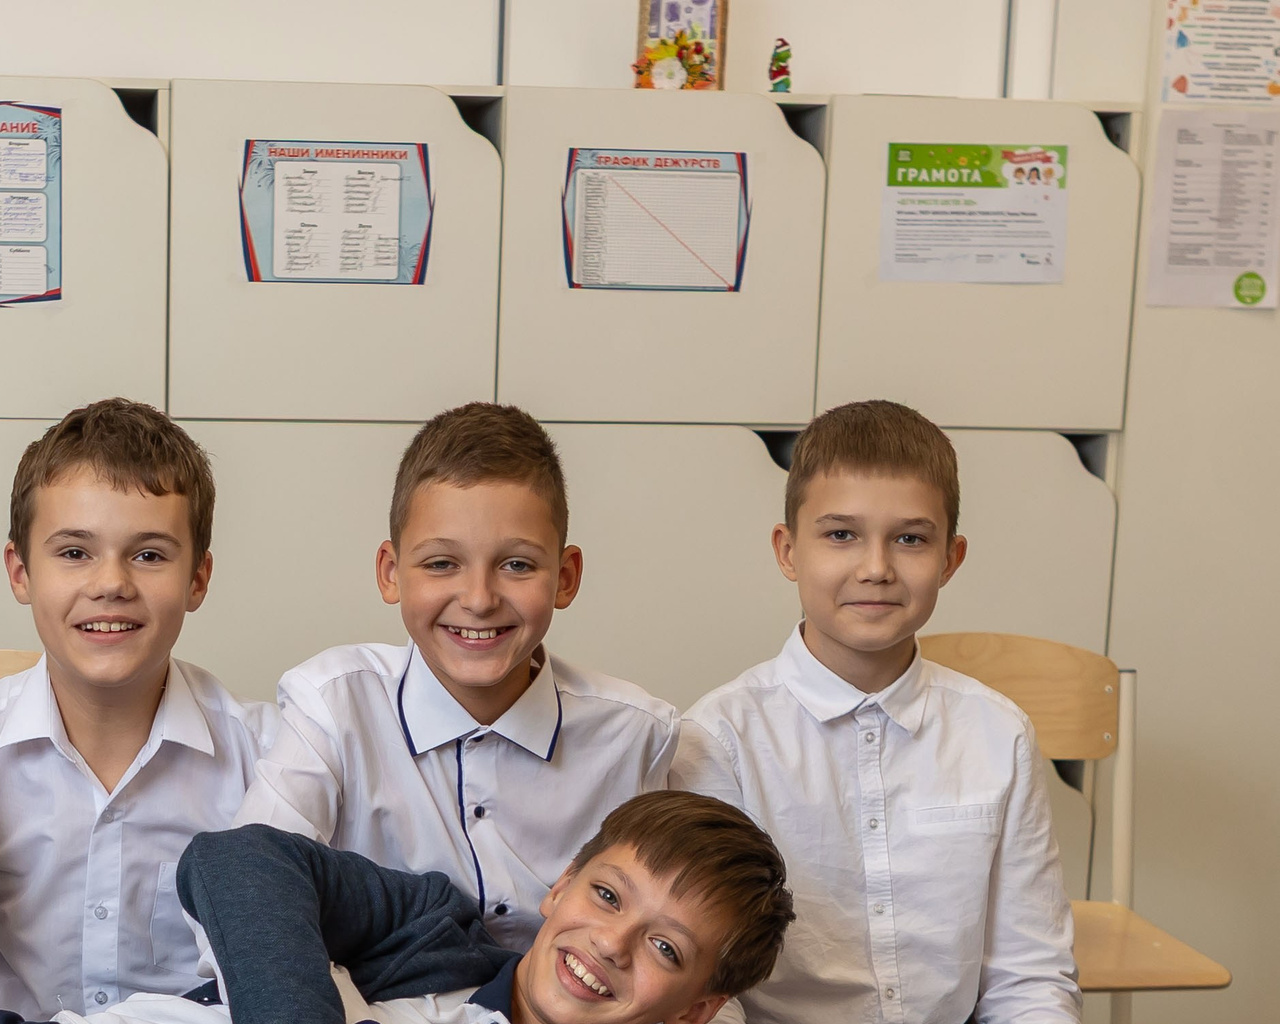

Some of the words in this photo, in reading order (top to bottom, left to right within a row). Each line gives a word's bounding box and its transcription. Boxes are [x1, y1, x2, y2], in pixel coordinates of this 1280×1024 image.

[267, 148, 310, 158] НАШИ
[314, 149, 408, 160] ИМЕНИННИКИ
[597, 155, 649, 167] ГРАФИК
[653, 157, 721, 169] ДЕЖУРСТВ
[897, 167, 983, 183] ГРАМОТА
